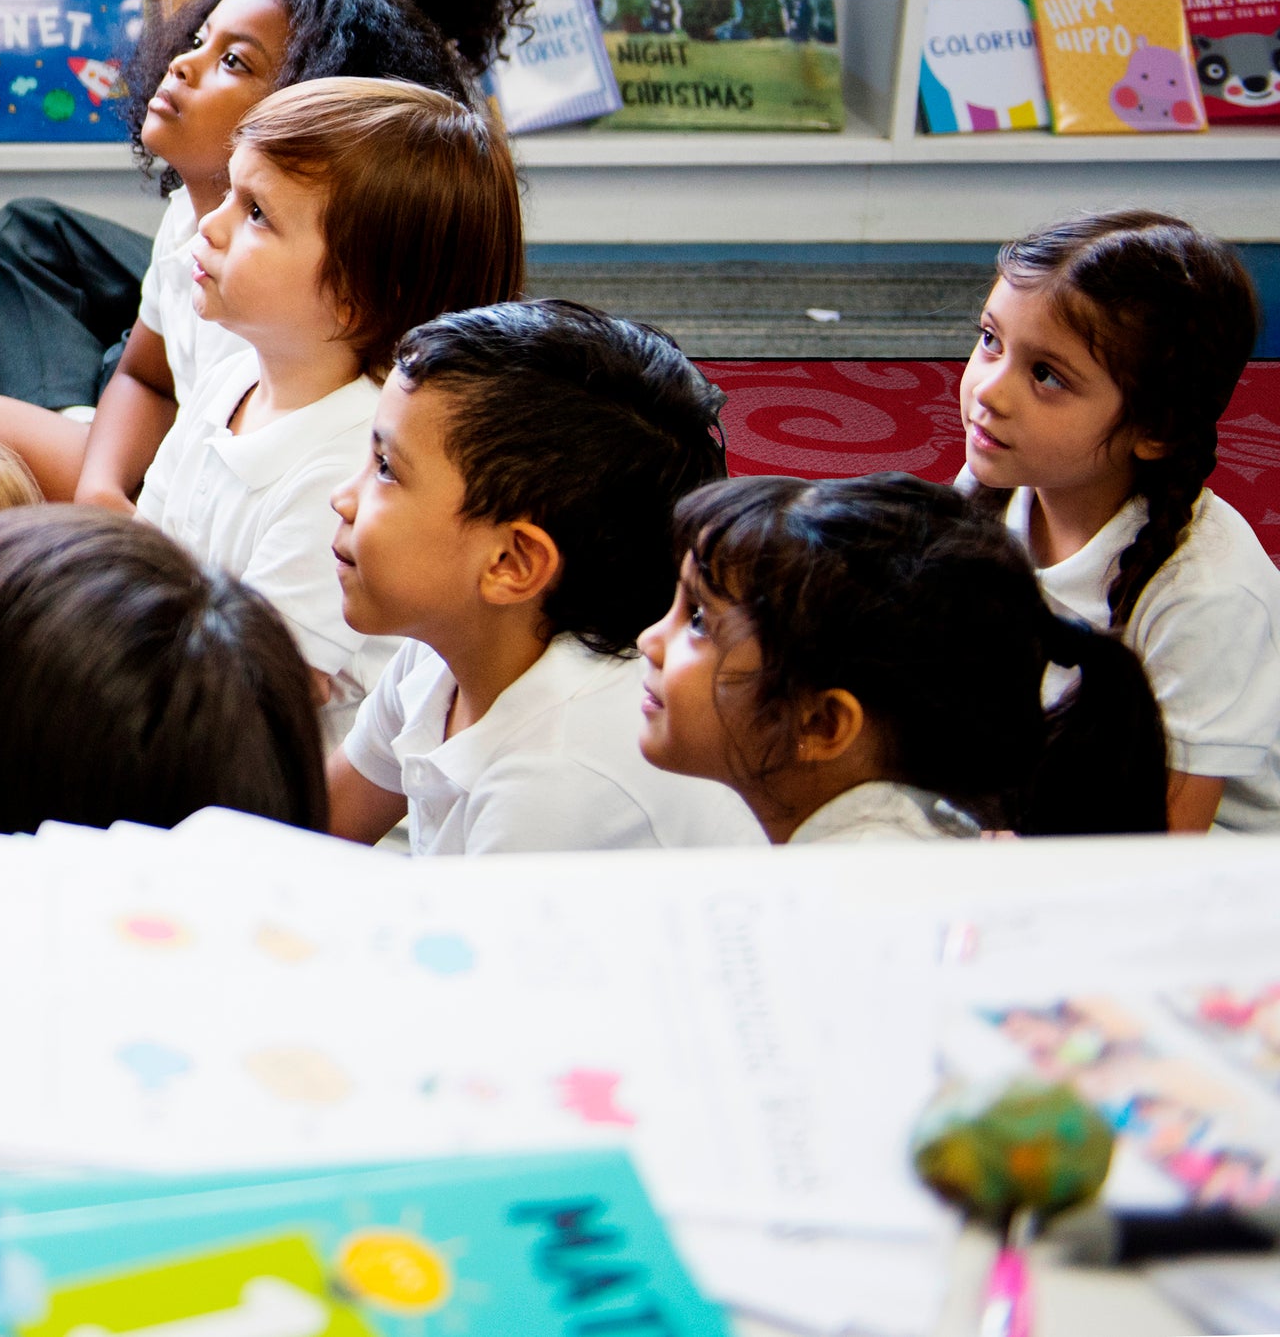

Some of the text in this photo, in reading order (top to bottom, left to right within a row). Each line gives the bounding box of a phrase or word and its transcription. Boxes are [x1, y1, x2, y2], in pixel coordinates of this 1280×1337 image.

[618, 42, 687, 66] NIGHT
[929, 29, 1033, 58] COLORFU
[1055, 24, 1132, 57] HIPPO
[621, 80, 753, 110] CHRISTMAS
